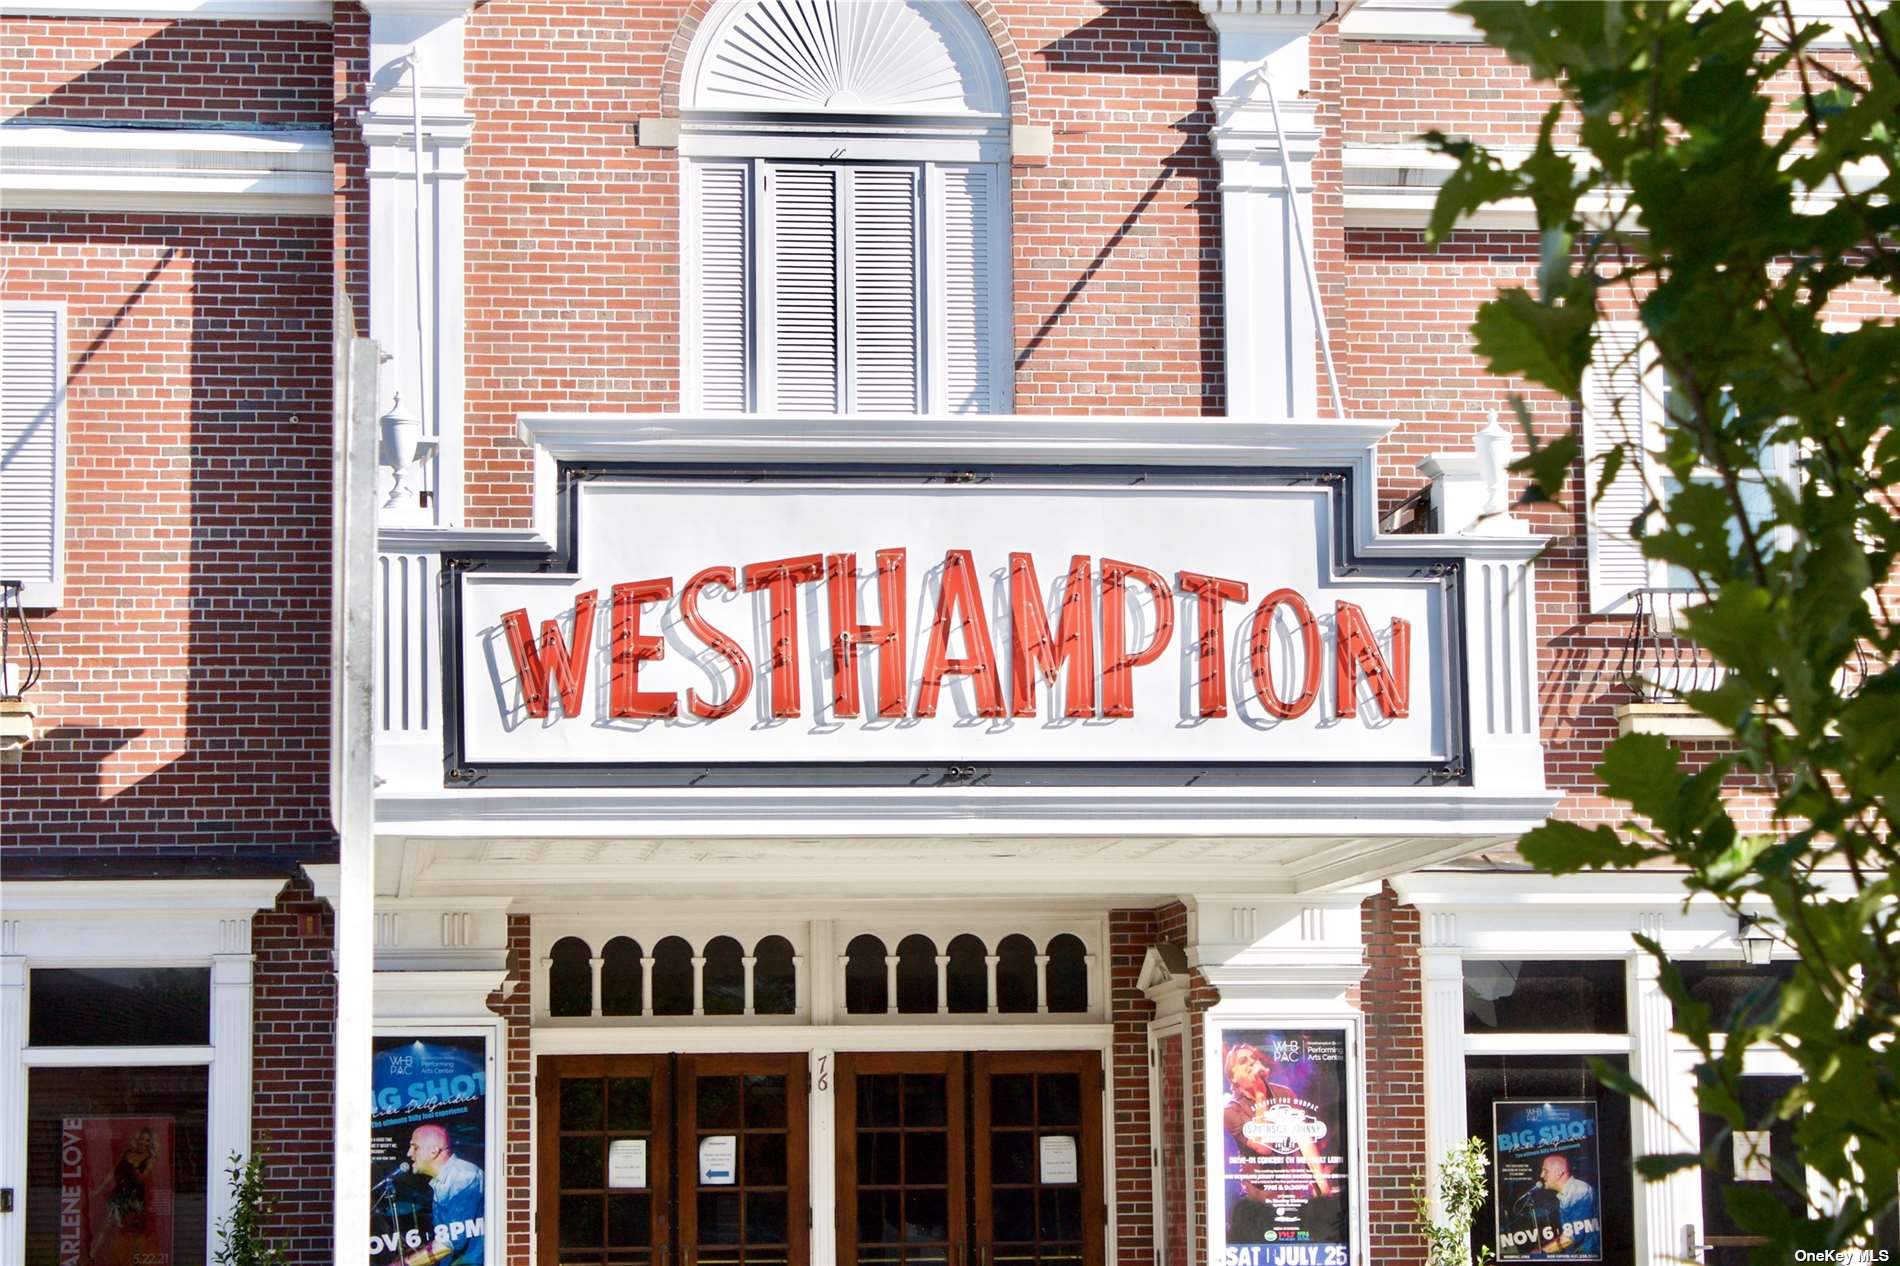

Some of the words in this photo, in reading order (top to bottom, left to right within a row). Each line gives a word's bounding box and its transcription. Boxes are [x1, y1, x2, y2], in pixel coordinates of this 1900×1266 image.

[500, 547, 1411, 719] WESTHAMPTON
[421, 1060, 455, 1068] Performing
[1274, 1052, 1299, 1062] PAC
[1308, 1046, 1344, 1054] Performing
[390, 1066, 412, 1075] PAC
[818, 1055, 828, 1091] 76
[372, 1085, 401, 1111] IG
[407, 1071, 485, 1105] SHOT
[62, 1118, 83, 1183] LOVE
[1498, 1129, 1536, 1152] BIG
[1538, 1119, 1594, 1143] SHOT
[369, 1232, 400, 1255] OV
[405, 1229, 421, 1248] 6
[433, 1217, 485, 1243] 8PM
[1500, 1228, 1538, 1248] NOV
[1542, 1226, 1554, 1240] 6
[1562, 1218, 1600, 1237] 8PM
[1226, 1246, 1261, 1266] SAT
[1274, 1246, 1319, 1266] JULY
[1324, 1246, 1348, 1266] 25
